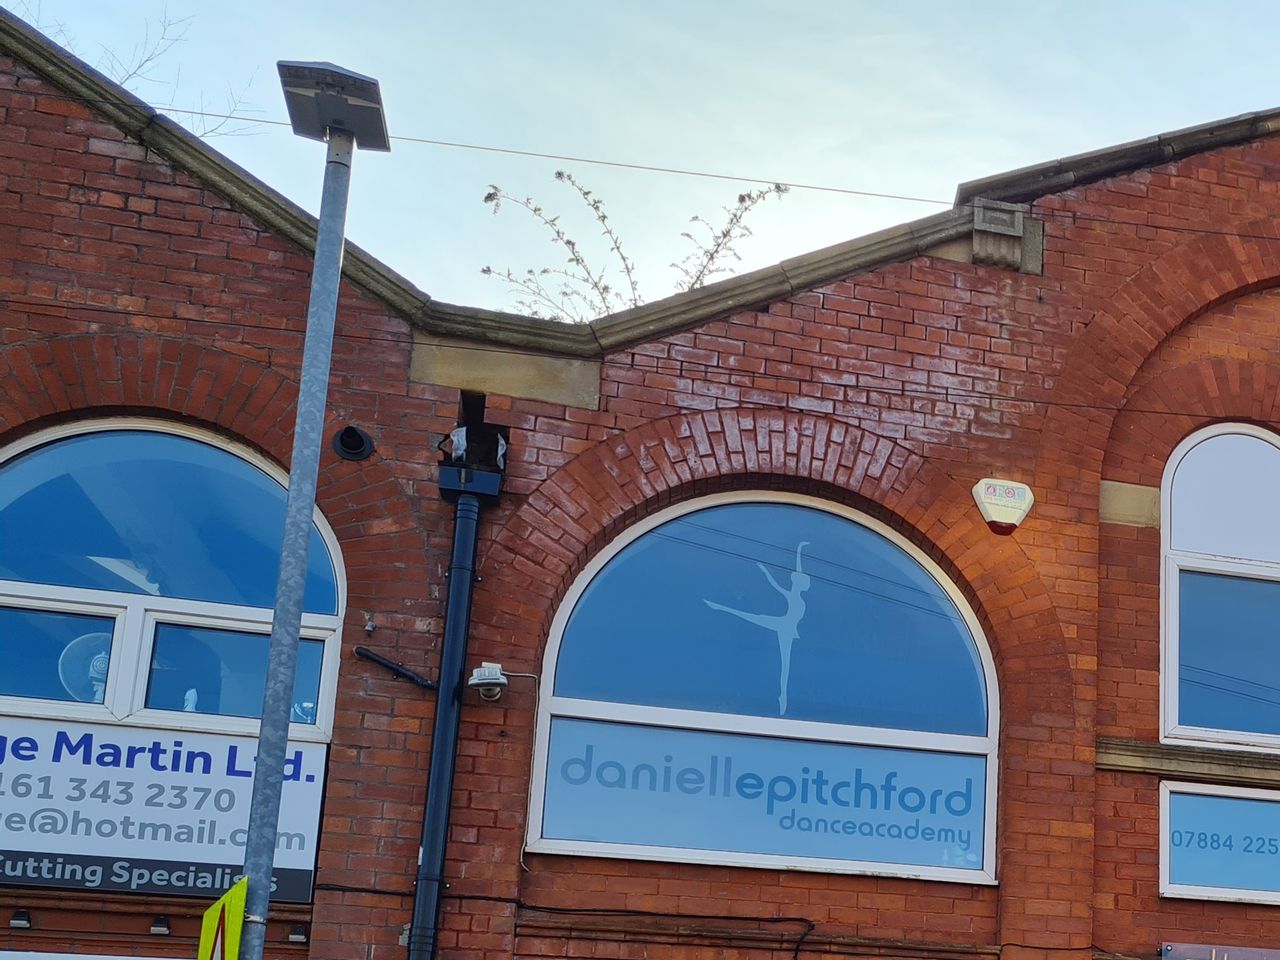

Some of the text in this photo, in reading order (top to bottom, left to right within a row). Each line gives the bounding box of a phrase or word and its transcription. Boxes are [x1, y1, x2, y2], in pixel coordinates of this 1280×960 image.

[51, 730, 212, 774] Martin
[226, 746, 316, 783] Ld.
[65, 777, 135, 805] 343
[145, 783, 236, 813] 2370
[560, 744, 972, 817] daniellepitchford
[0, 808, 305, 850] e@hotmail.cm
[779, 808, 971, 851] danceacademy
[1171, 830, 1233, 851] 07884
[0, 855, 278, 892] utting Specialis
